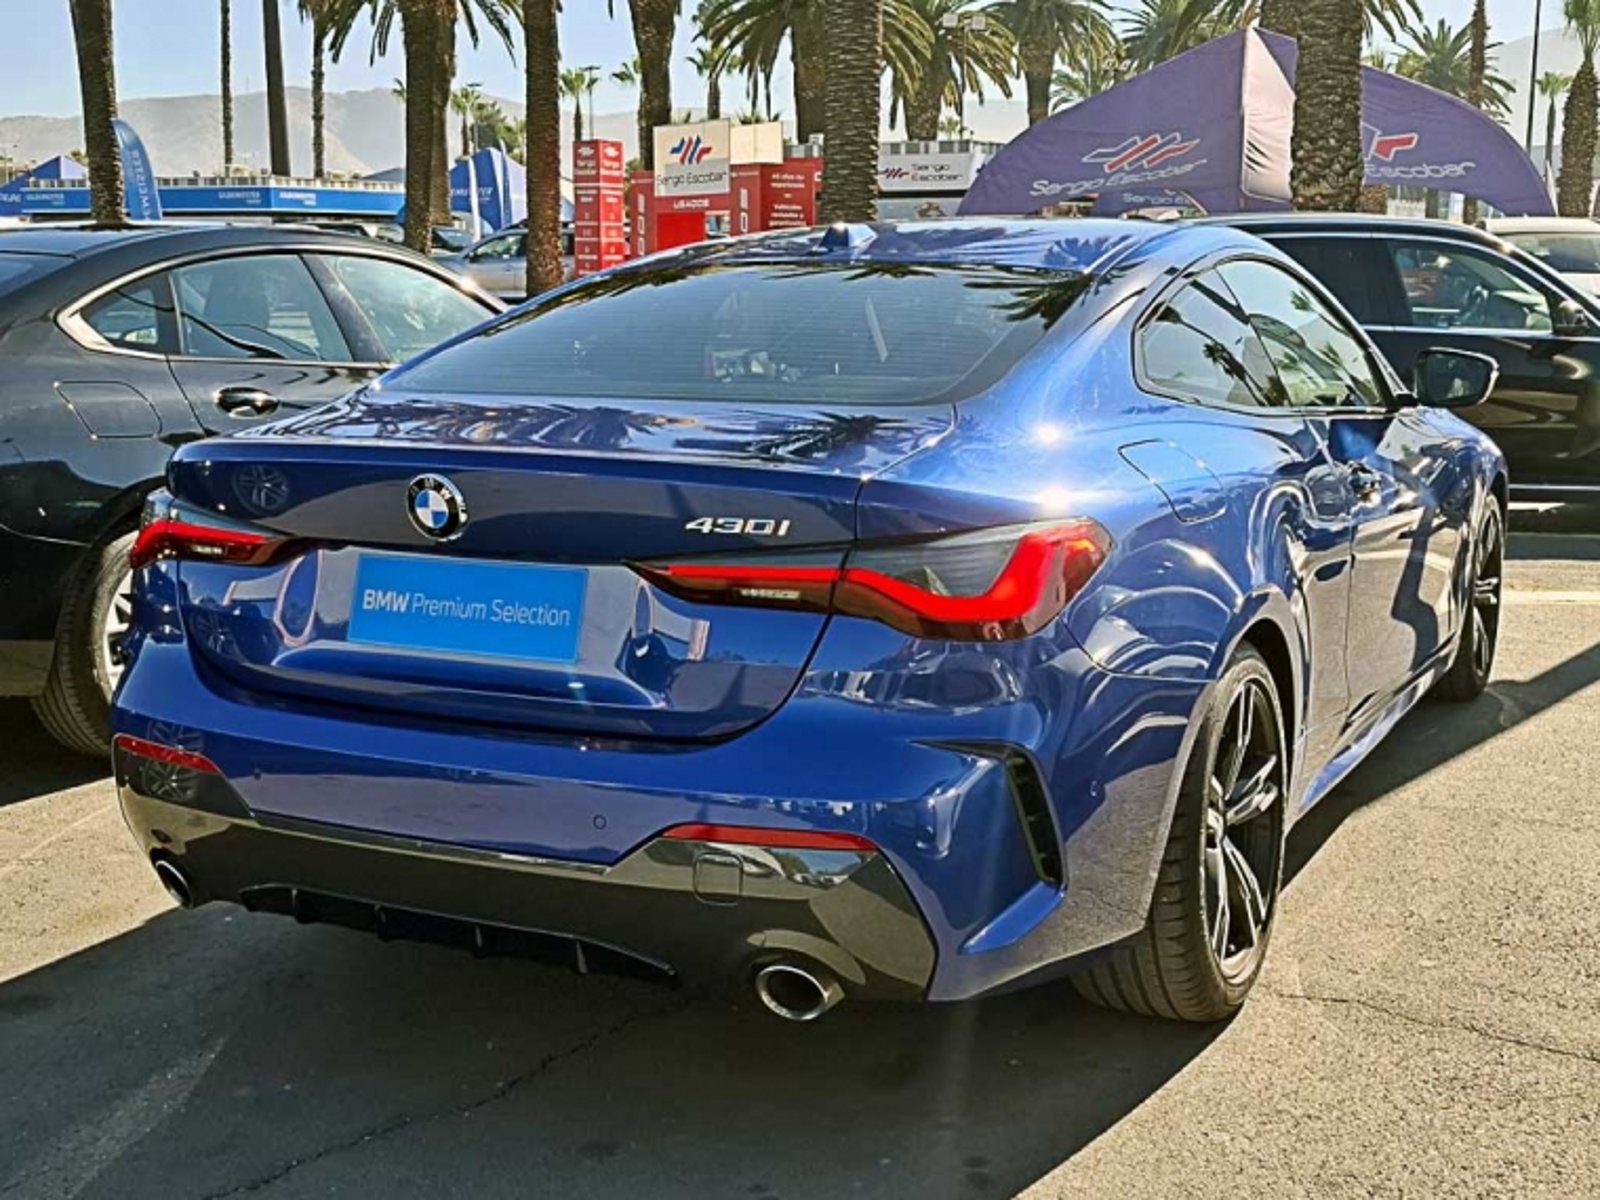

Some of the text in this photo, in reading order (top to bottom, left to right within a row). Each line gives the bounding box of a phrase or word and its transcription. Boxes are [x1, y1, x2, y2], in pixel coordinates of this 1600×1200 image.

[1364, 161, 1476, 178] Escobar
[361, 588, 571, 627] BMW Premium Selection
